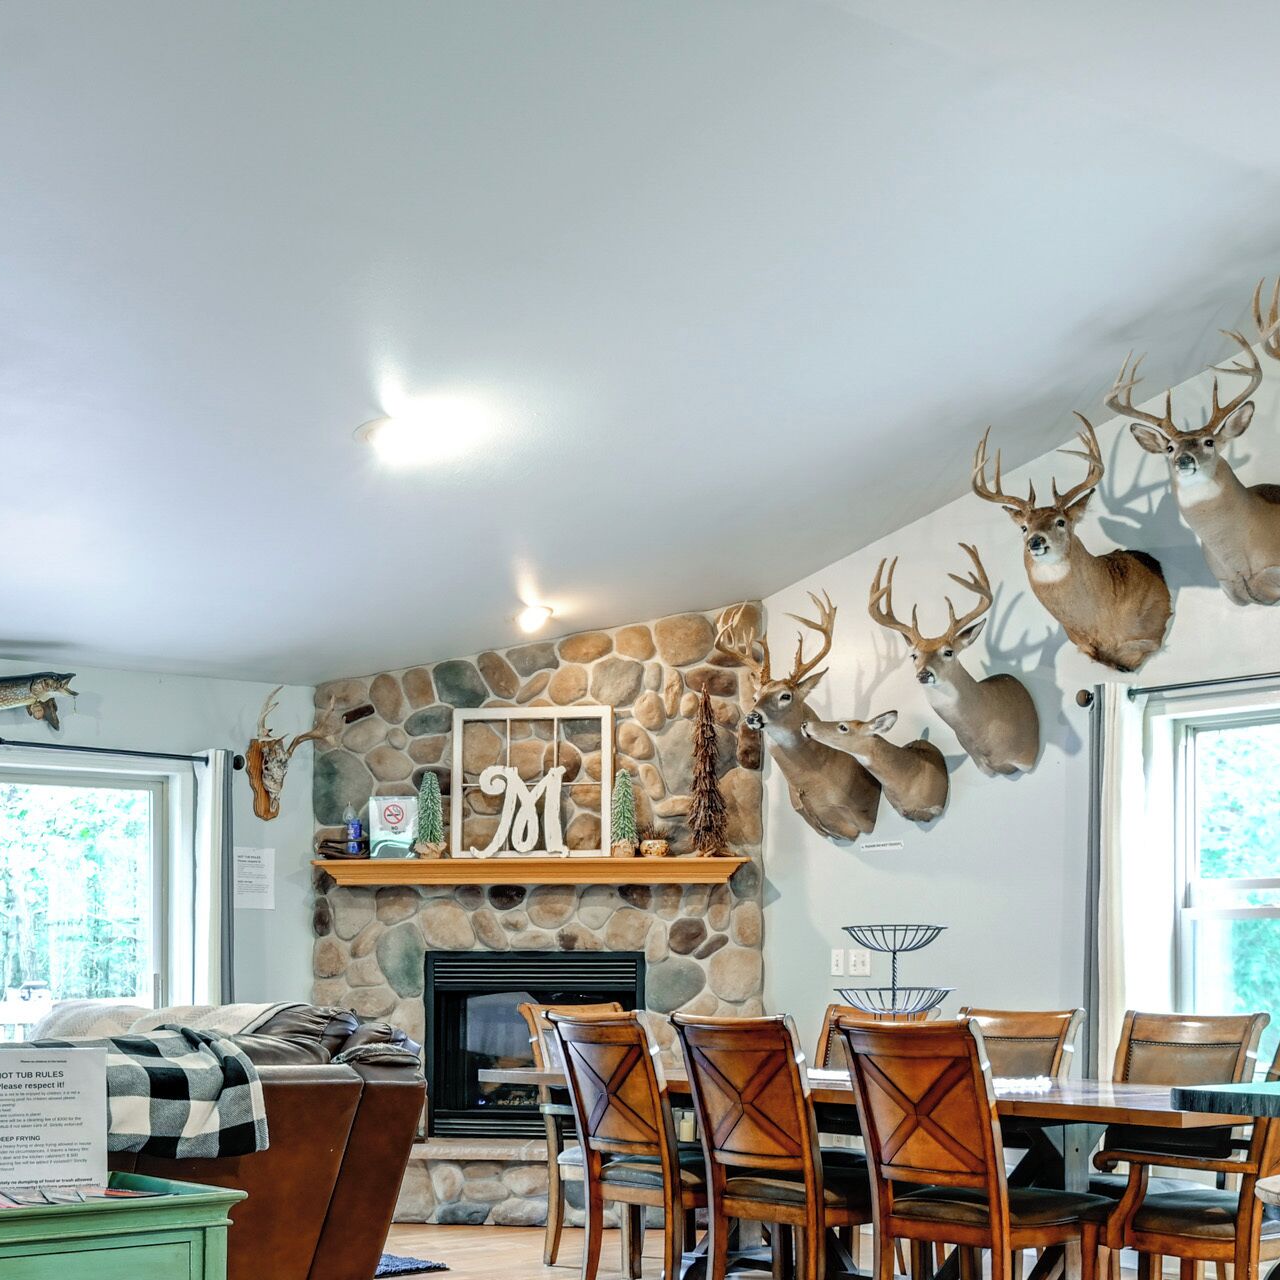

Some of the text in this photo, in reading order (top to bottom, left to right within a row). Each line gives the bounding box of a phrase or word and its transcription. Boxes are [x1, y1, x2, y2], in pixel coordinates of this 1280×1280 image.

[470, 765, 570, 858] M
[35, 1070, 64, 1078] RULES
[24, 1082, 55, 1090] respect
